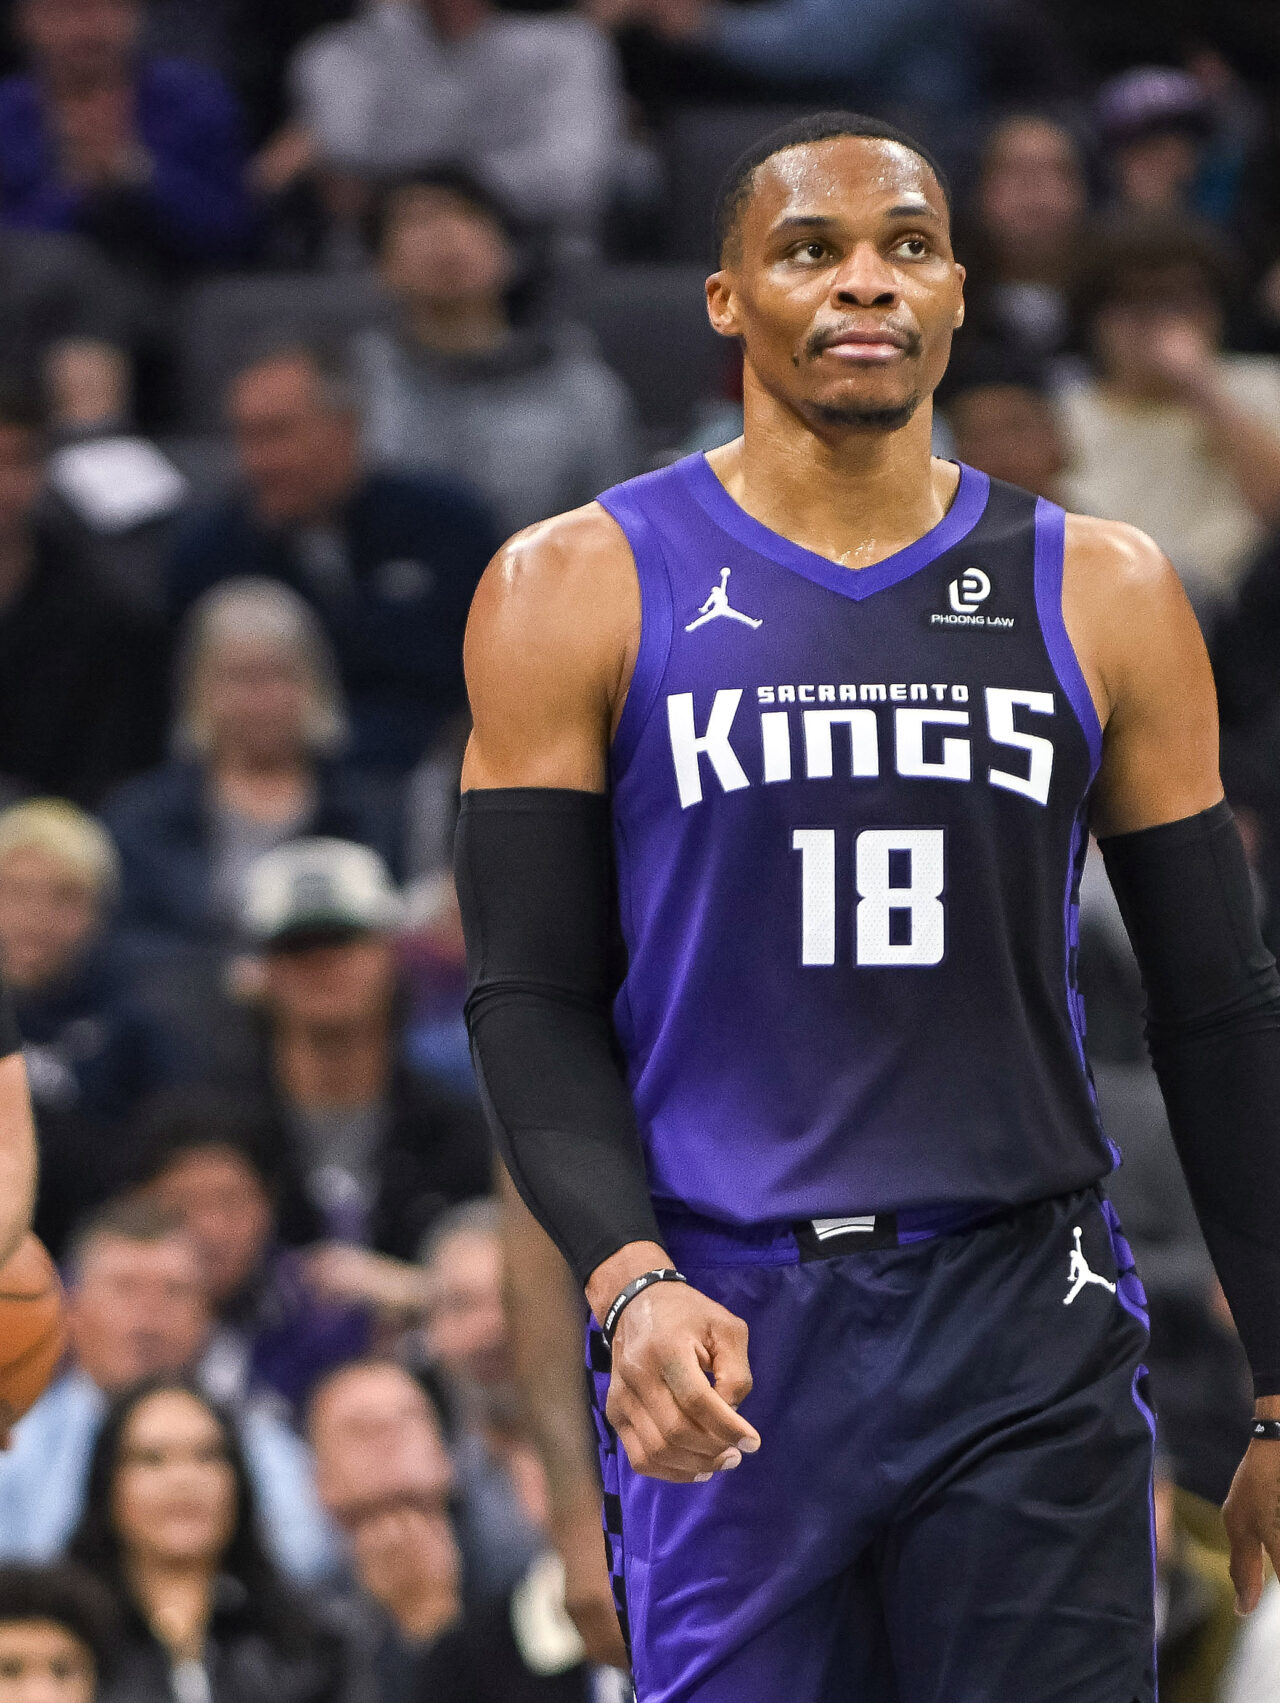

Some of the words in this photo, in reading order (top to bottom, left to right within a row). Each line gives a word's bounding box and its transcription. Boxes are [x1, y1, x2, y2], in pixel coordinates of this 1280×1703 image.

[931, 614, 985, 625] PHOONG
[986, 616, 1015, 627] LAW
[757, 683, 970, 704] SACRAMENTO
[791, 827, 947, 968] 18
